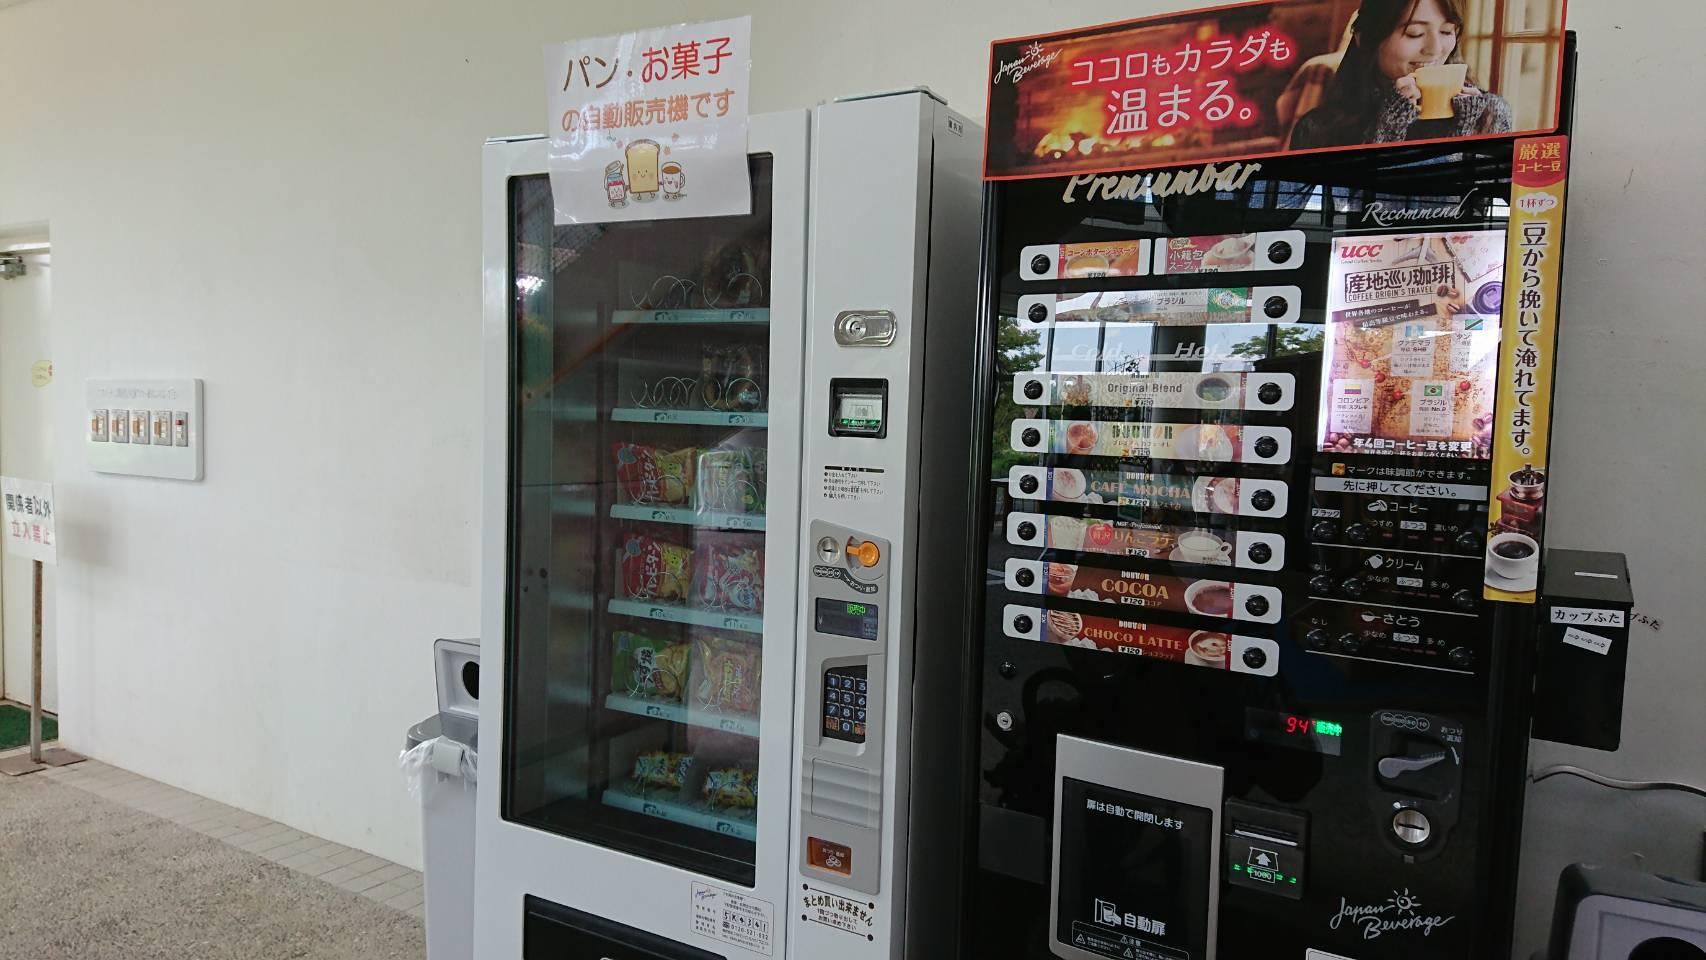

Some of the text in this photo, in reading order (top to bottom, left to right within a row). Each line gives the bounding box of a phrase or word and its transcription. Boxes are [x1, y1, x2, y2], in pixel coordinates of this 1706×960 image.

[563, 37, 733, 91] パン・お菓子
[1072, 31, 1290, 86] ココロもカラダも
[561, 88, 735, 132] の自動販売機です
[1106, 79, 1252, 134] 温まる。
[1519, 143, 1561, 160] 厳選
[1516, 161, 1561, 173] コーヒー豆
[1361, 188, 1479, 227] Recommend
[1519, 198, 1555, 209] 1杯ずつ
[1348, 264, 1450, 293] 産地巡り珈琲
[1156, 297, 1186, 306] ブラジル
[1348, 293, 1373, 302] COFFEE
[1408, 285, 1433, 294] TRAVEL
[1511, 221, 1548, 455] 豆から挽いて淹れてます。
[1107, 379, 1183, 394] Original Blend
[1353, 438, 1473, 453] 年4回コーヒー豆を変更
[1133, 483, 1192, 500] MOCHA
[1343, 480, 1457, 498] 先に押してください。
[1389, 502, 1429, 513] コーヒー
[1385, 558, 1424, 571] クリーム
[1101, 579, 1169, 600] COCOA
[1123, 597, 1144, 605] ¥120
[1383, 613, 1421, 627] さとう
[1554, 608, 1621, 624] カップふた
[1083, 627, 1184, 651] CHOCO LATTE
[1120, 647, 1141, 655] ¥120
[1085, 798, 1185, 831] 扉は自動で開閉します
[1253, 869, 1273, 881] 1000
[803, 895, 873, 927] まとめ買い出来ません
[1329, 896, 1395, 930] Japan
[1123, 912, 1167, 937] 自動扉
[1357, 916, 1456, 940] Beverage
